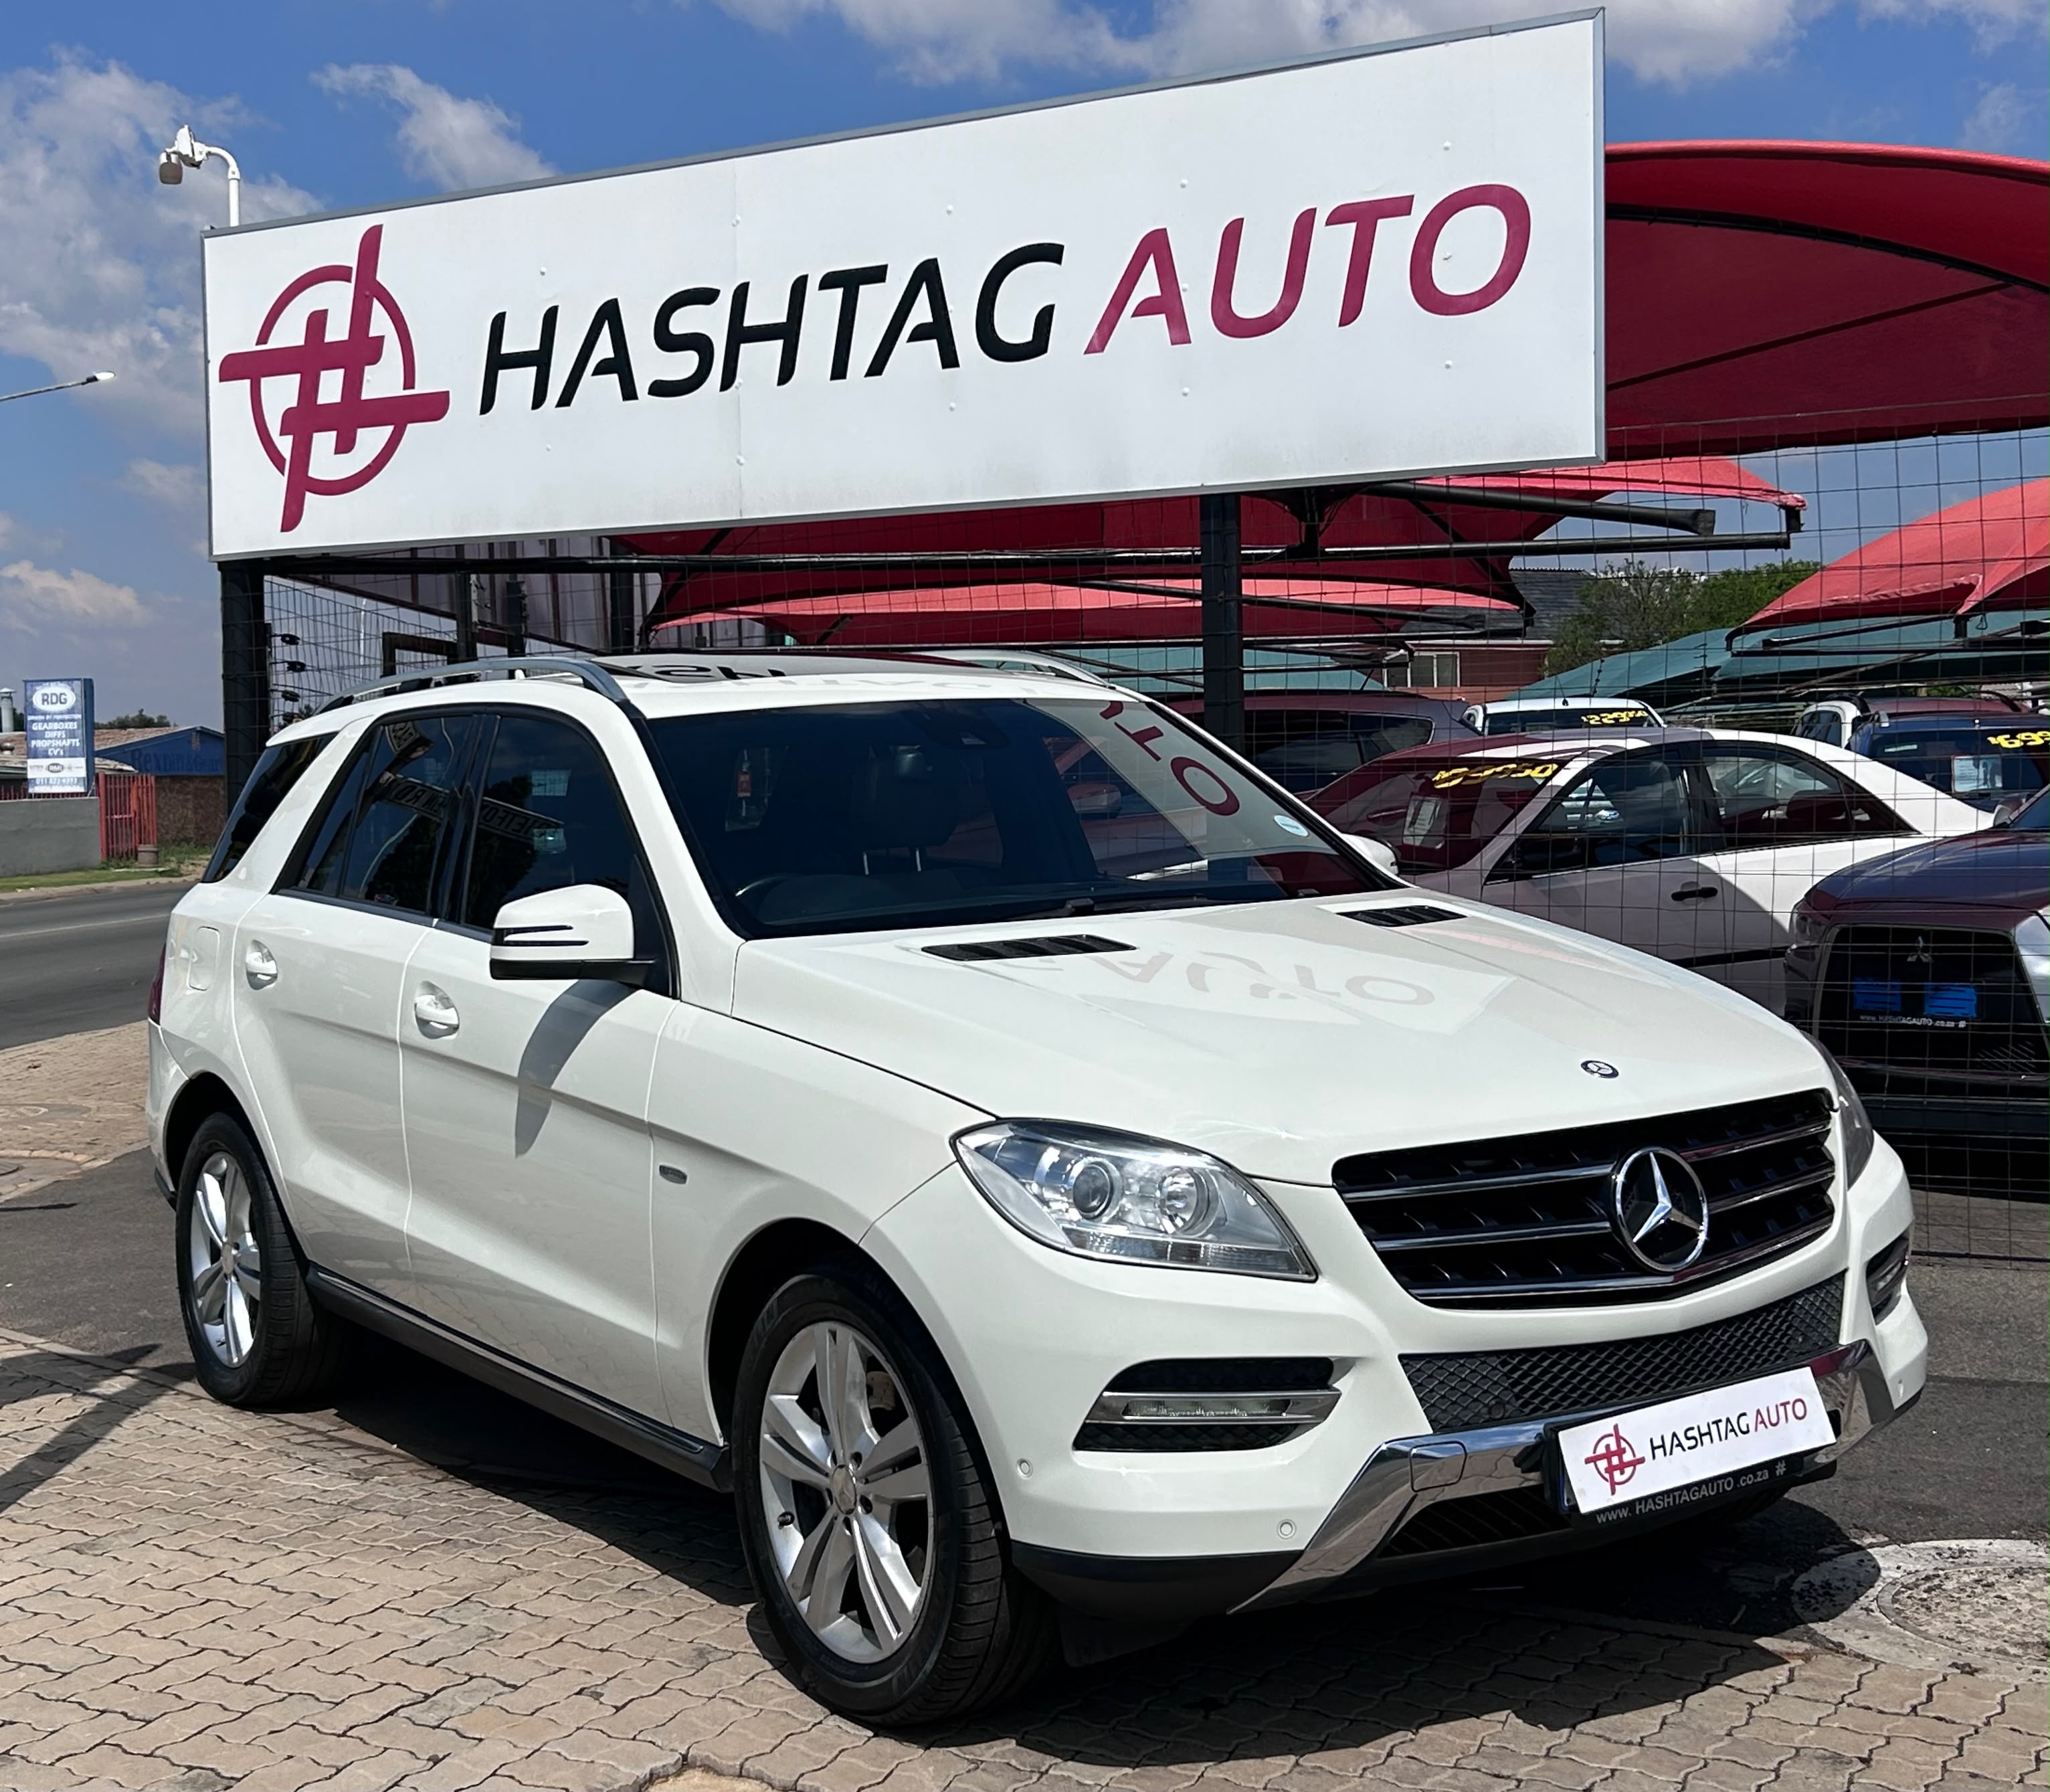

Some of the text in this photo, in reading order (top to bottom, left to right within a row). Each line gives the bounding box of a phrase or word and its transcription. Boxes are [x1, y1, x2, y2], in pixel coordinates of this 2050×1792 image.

[480, 184, 1531, 415] HASHTAG AUTO
[41, 692, 68, 705] RDG
[32, 722, 78, 730] GEARBOXES
[44, 730, 66, 738] DIFFS
[31, 738, 80, 748] PROPSHAFTS
[1649, 1397, 1808, 1460] HASHTAG AUTO
[1596, 1504, 1632, 1524] www.
[1635, 1477, 1734, 1514] HASHTAGAUTO
